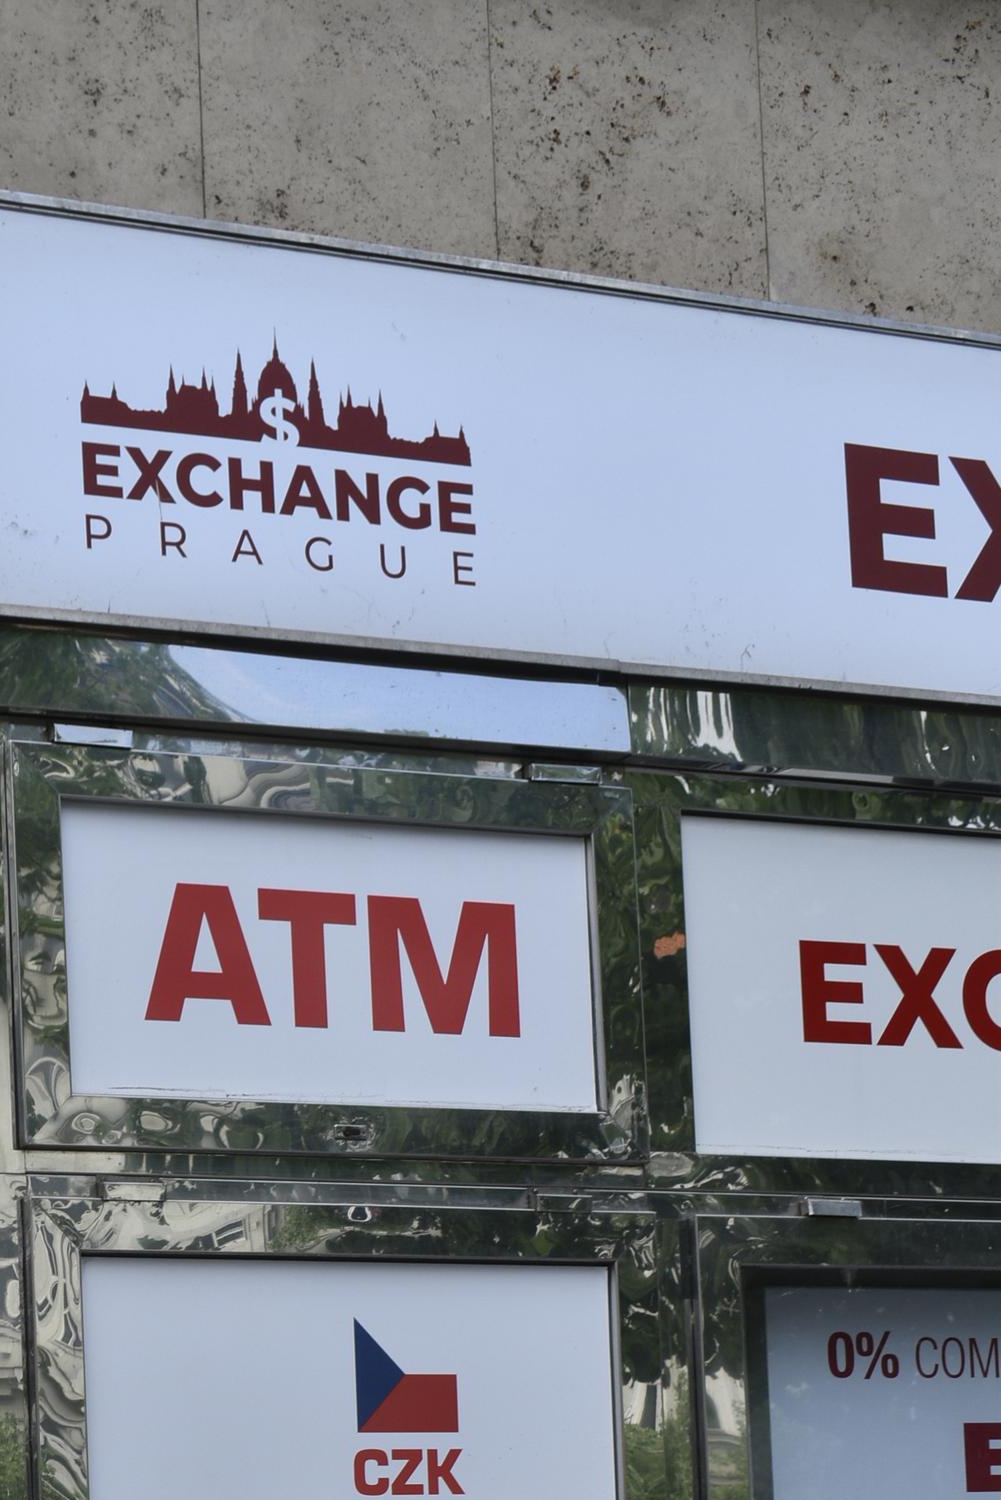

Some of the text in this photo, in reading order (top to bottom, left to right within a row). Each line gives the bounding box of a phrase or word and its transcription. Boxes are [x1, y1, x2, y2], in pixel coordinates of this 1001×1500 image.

[81, 441, 477, 536] EXCHANGE
[85, 513, 477, 587] PRAGUE
[144, 882, 521, 1038] ATM
[827, 1330, 1001, 1380] 0% COM
[353, 1448, 465, 1496] CZK
